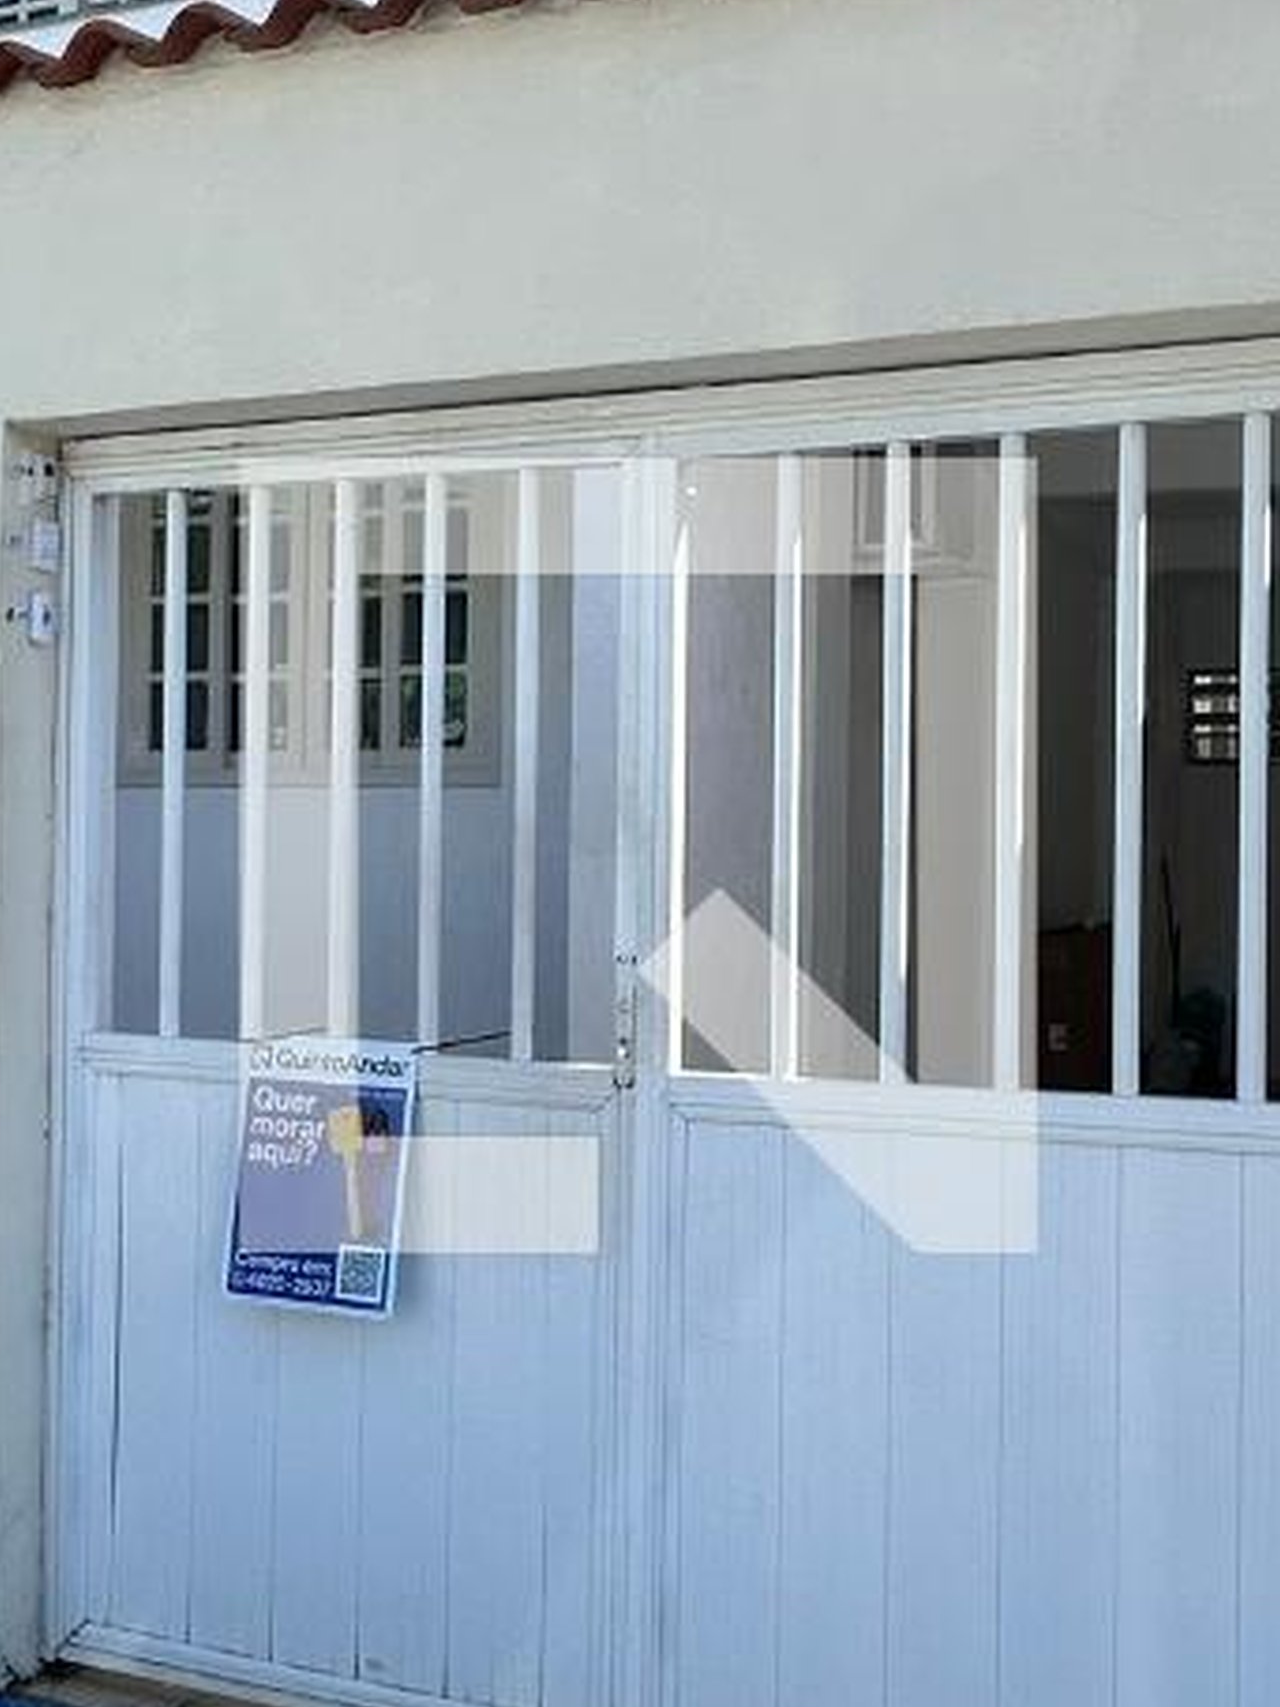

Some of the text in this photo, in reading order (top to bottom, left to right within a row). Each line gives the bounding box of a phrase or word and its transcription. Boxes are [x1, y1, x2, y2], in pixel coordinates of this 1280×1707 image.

[253, 1086, 317, 1114] Quer
[250, 1117, 325, 1140] morar
[248, 1139, 319, 1169] aqui?
